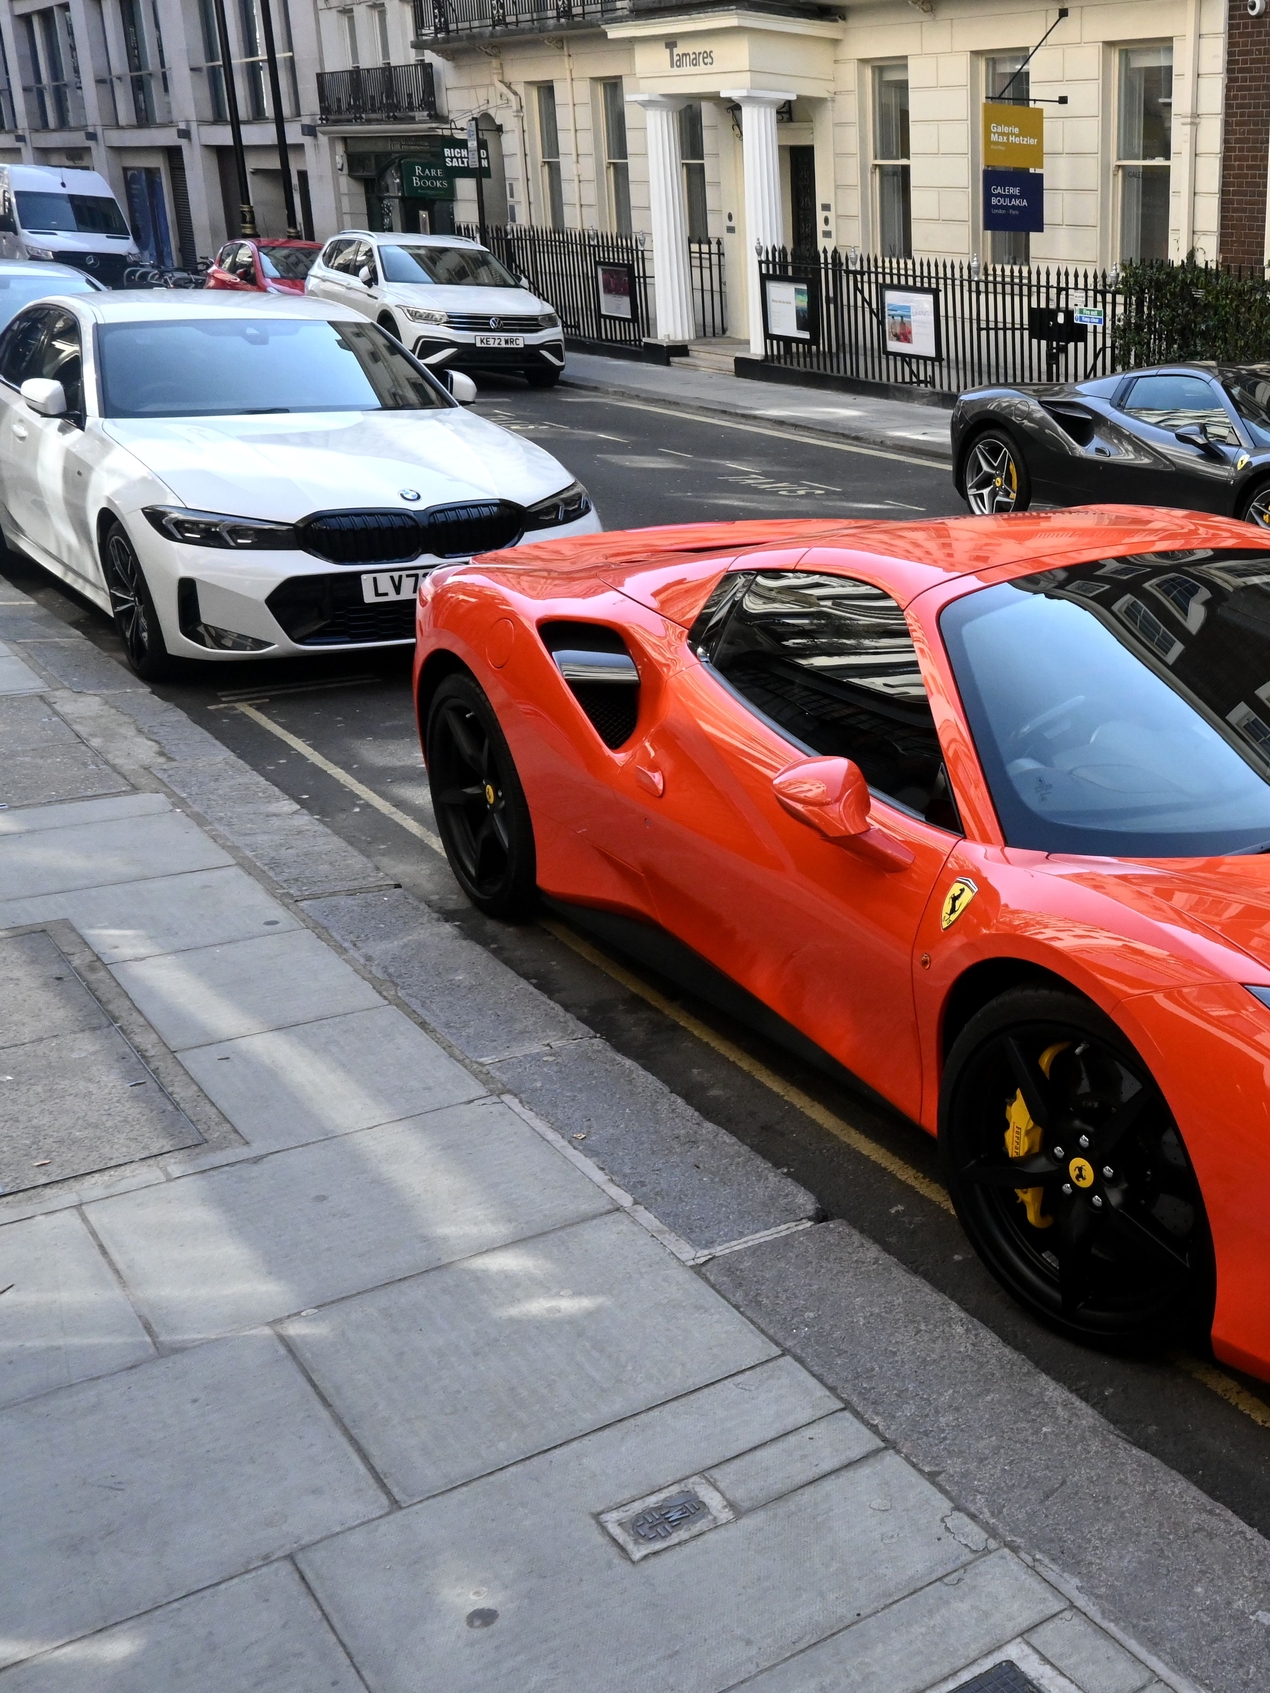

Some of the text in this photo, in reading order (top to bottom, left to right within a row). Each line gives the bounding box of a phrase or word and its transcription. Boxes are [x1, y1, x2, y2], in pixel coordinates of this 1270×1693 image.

[665, 41, 714, 68] Tamares
[991, 123, 1019, 134] Galerie
[991, 133, 1038, 145] Max Hetzler
[444, 148, 487, 158] RICHD
[445, 157, 488, 168] SALTN
[991, 185, 1021, 196] GALERIE
[991, 196, 1028, 207] BOULAKIA
[480, 337, 520, 346] KE72 WRC
[373, 572, 430, 597] LV7
